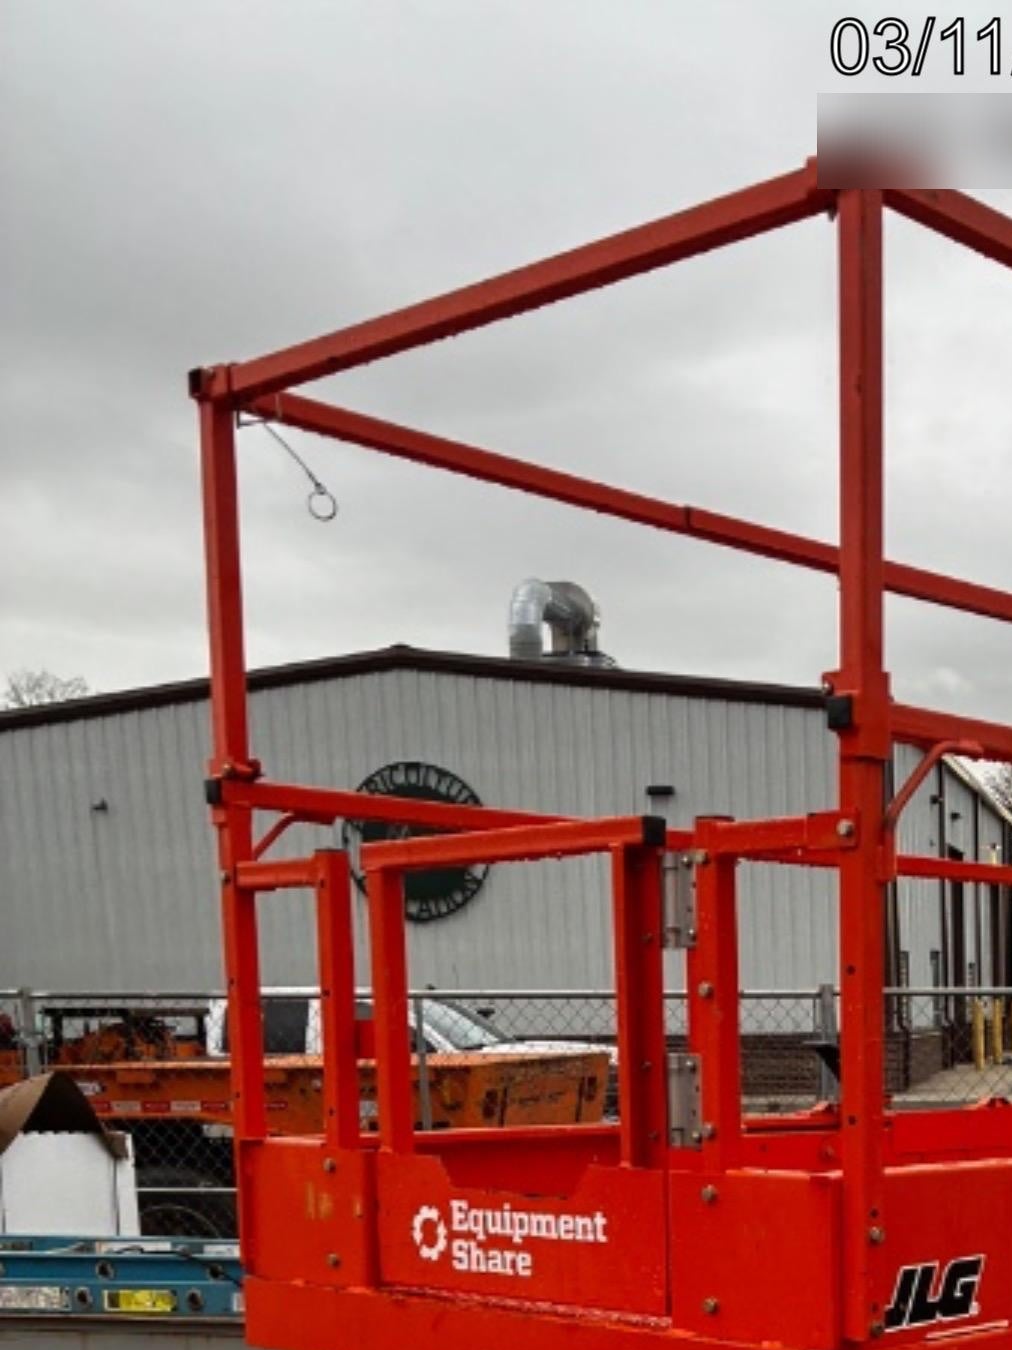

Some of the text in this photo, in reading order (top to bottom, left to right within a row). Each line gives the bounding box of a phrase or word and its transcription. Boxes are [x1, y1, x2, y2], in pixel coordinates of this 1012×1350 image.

[450, 1199, 608, 1244] Equipment
[451, 1238, 533, 1277] Share
[884, 1253, 986, 1333] JLG
